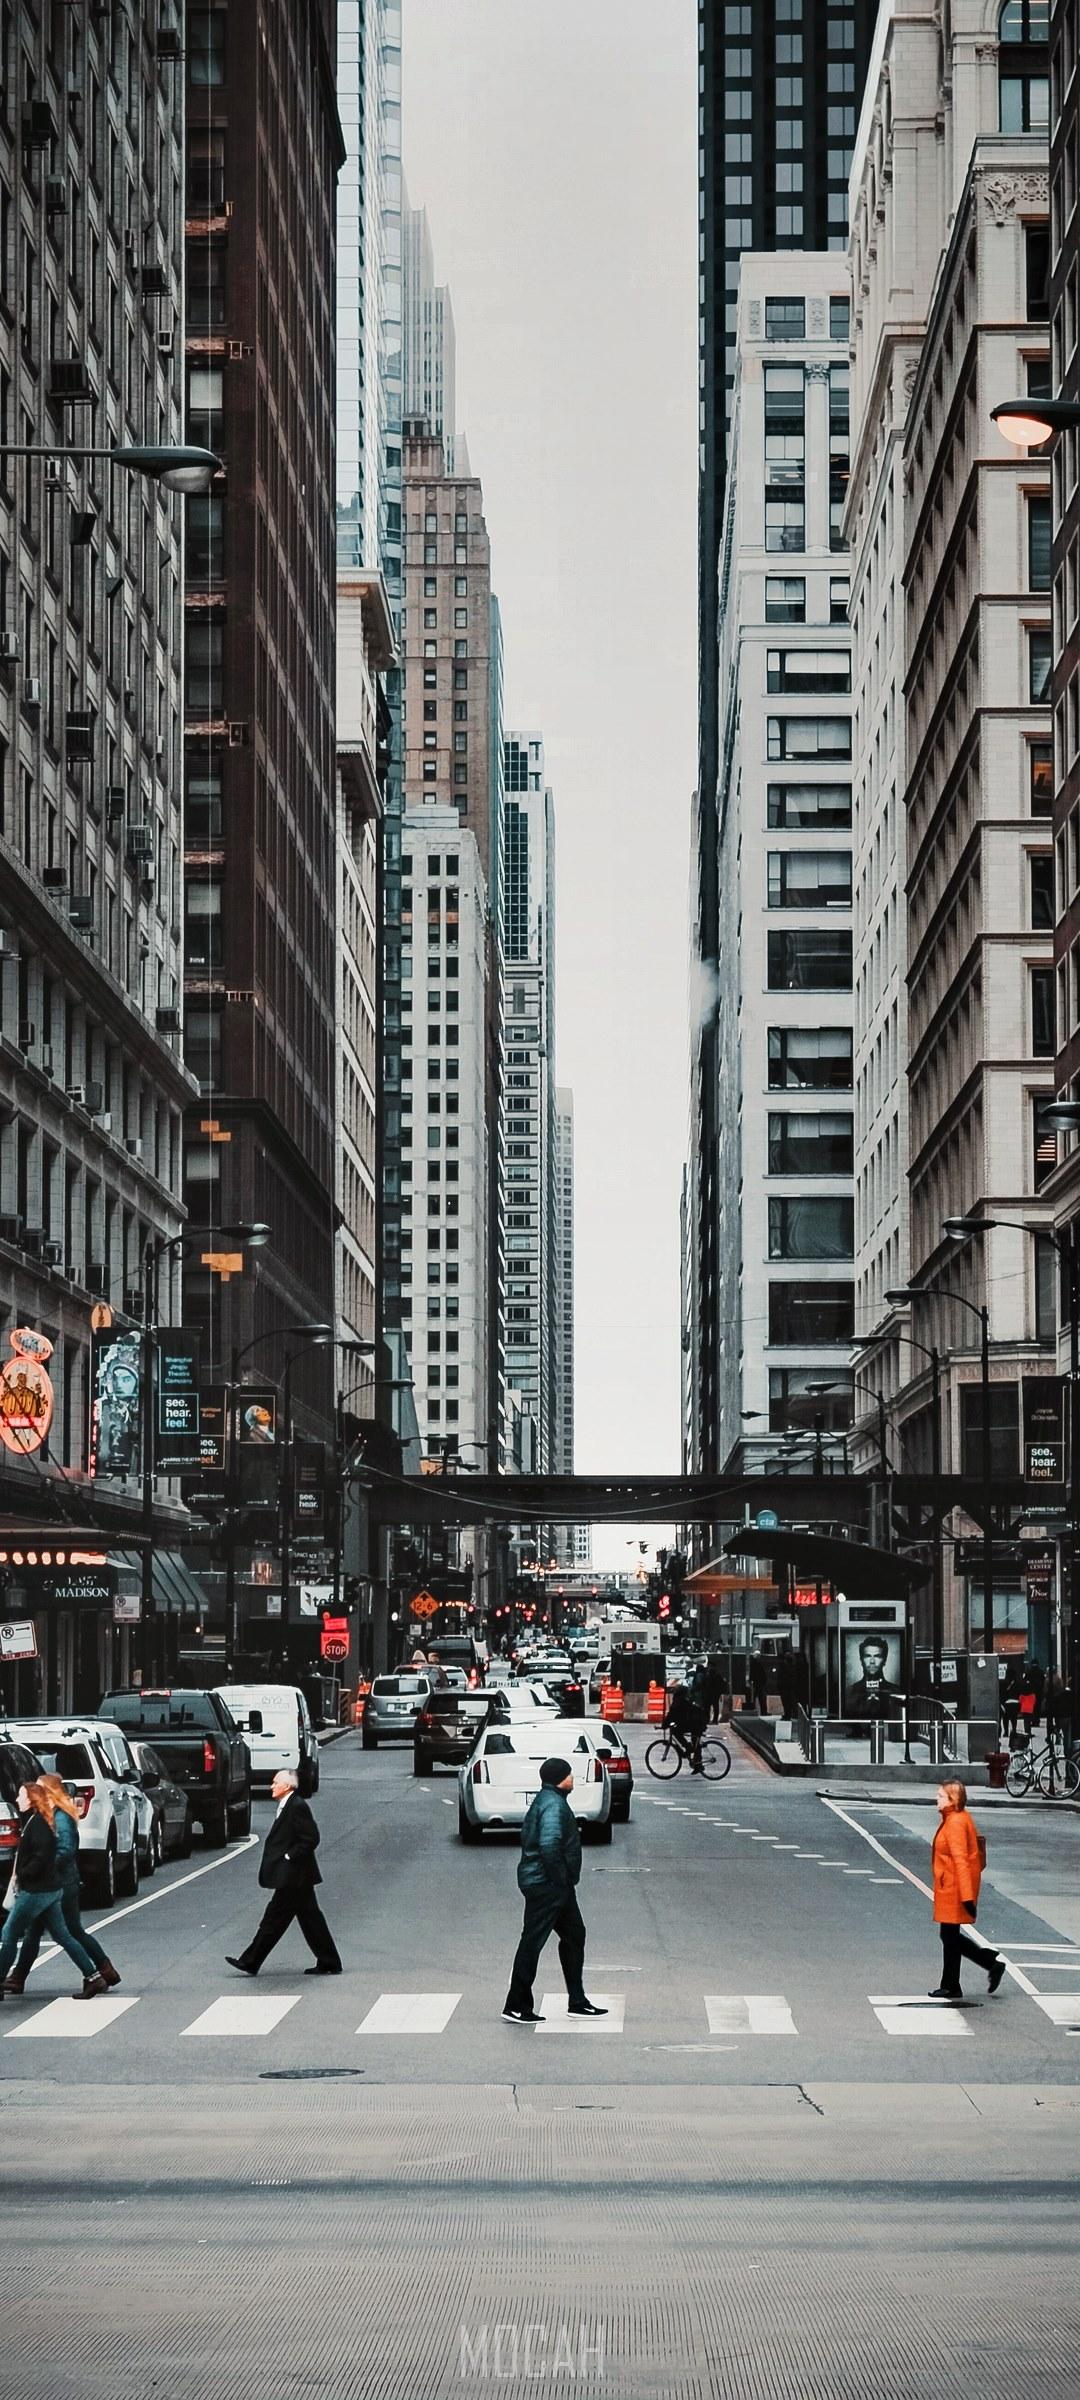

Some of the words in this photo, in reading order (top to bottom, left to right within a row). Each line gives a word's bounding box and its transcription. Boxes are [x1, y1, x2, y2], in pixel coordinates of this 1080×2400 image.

[165, 1399, 188, 1407] see.
[165, 1408, 192, 1418] hear.
[165, 1418, 188, 1428] feel.
[1031, 1448, 1053, 1456] see.
[1031, 1457, 1057, 1467] hear.
[1031, 1467, 1053, 1477] feel.
[55, 1587, 109, 1597] MADISON
[326, 1645, 347, 1655] STOP
